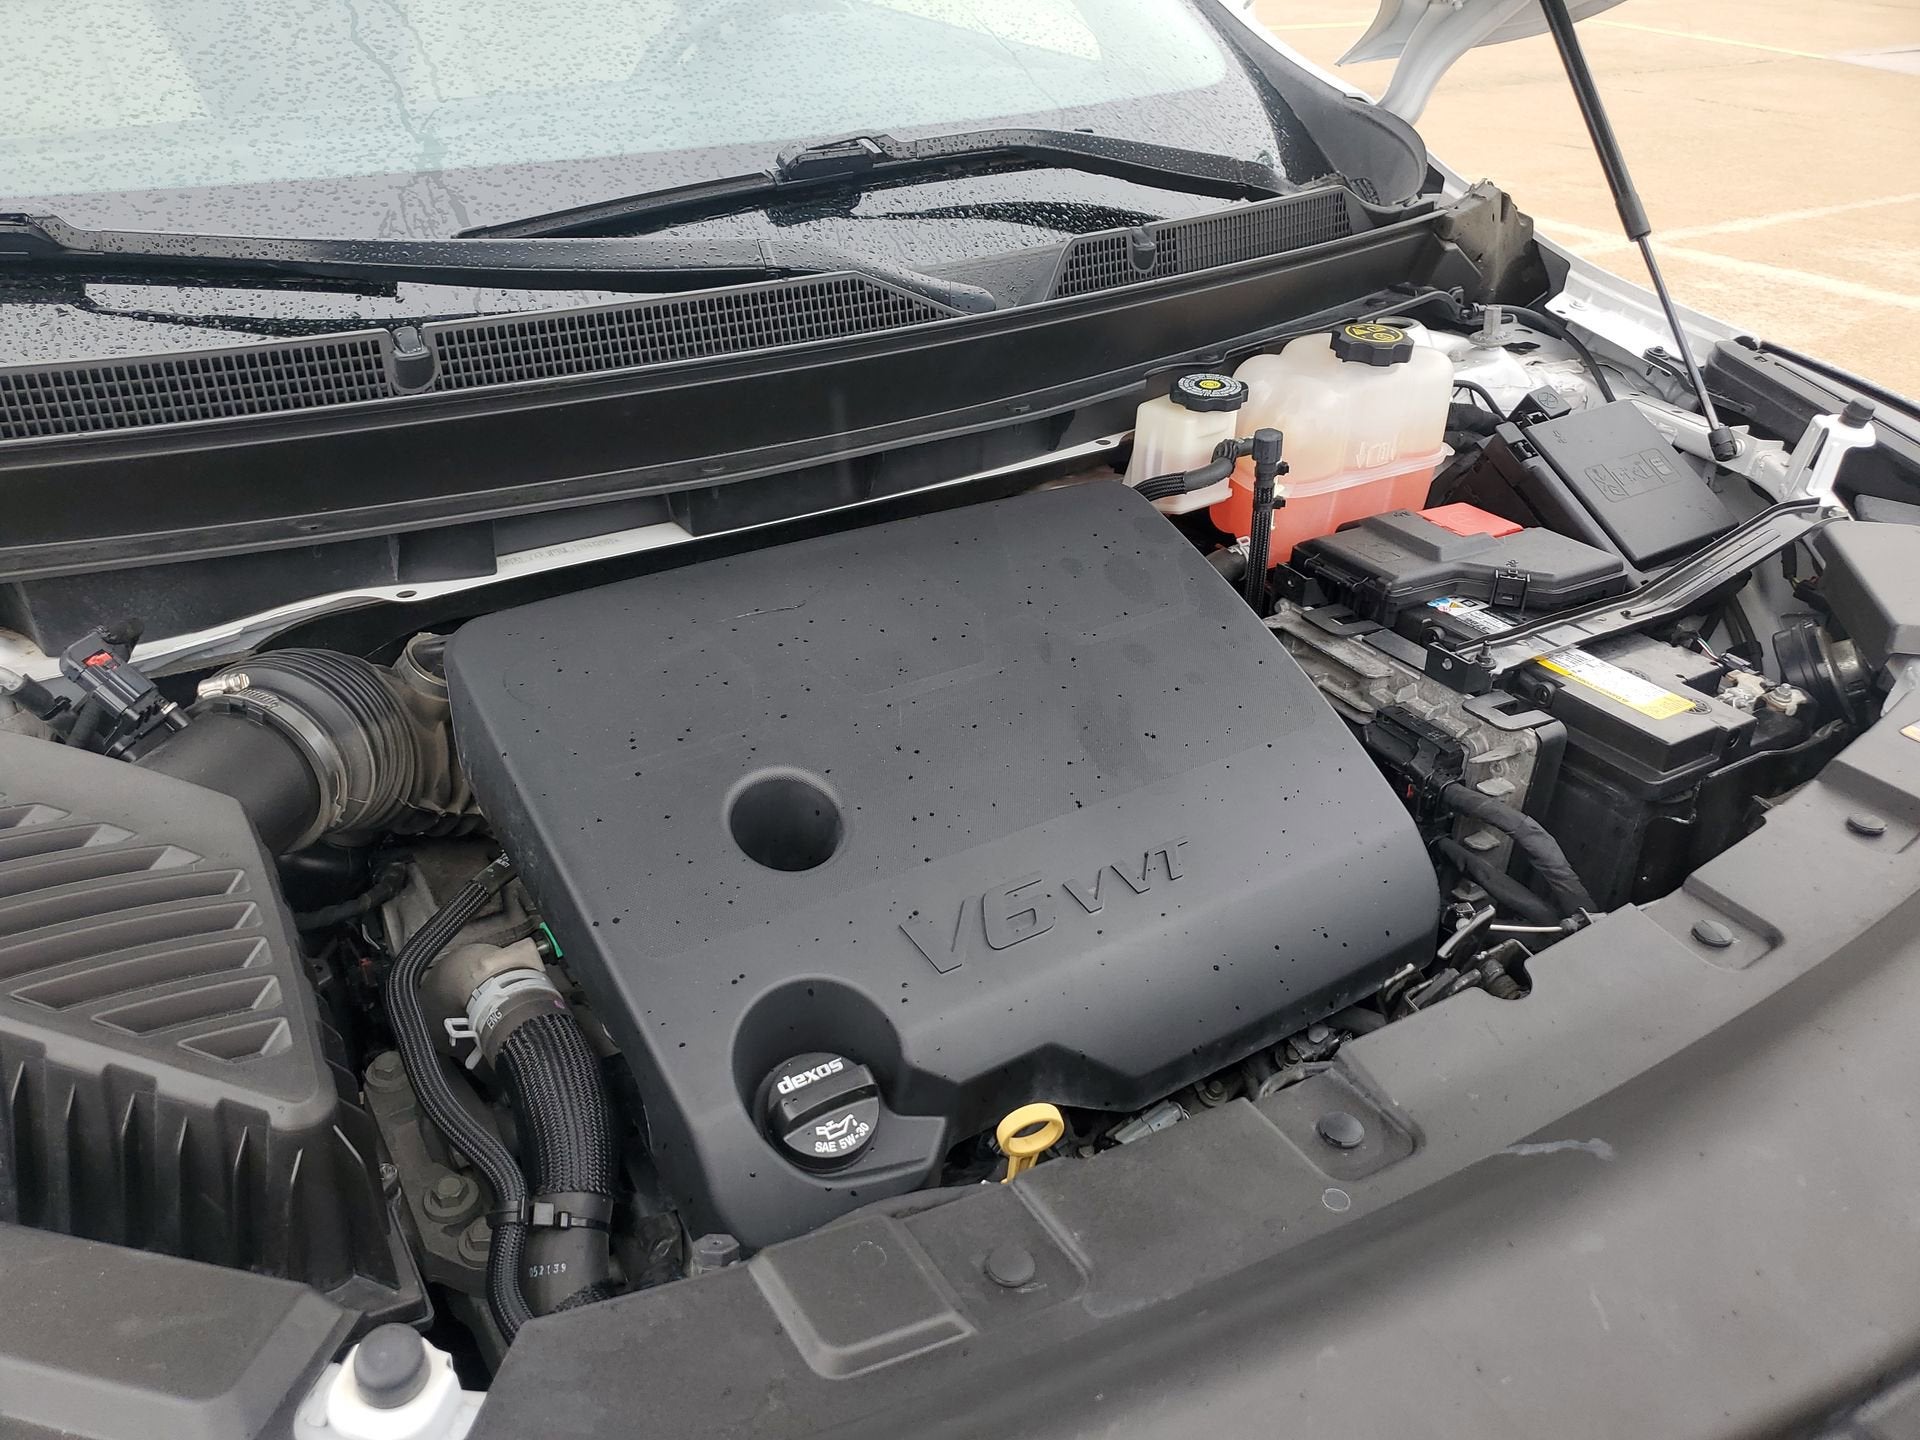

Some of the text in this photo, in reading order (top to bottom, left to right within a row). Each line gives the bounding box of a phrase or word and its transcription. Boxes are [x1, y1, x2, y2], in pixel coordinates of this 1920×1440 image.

[898, 836, 1190, 975] V6 VVT
[486, 1009, 503, 1030] ENG
[777, 1057, 844, 1095] dexos
[814, 1122, 870, 1153] SAE 5W-30
